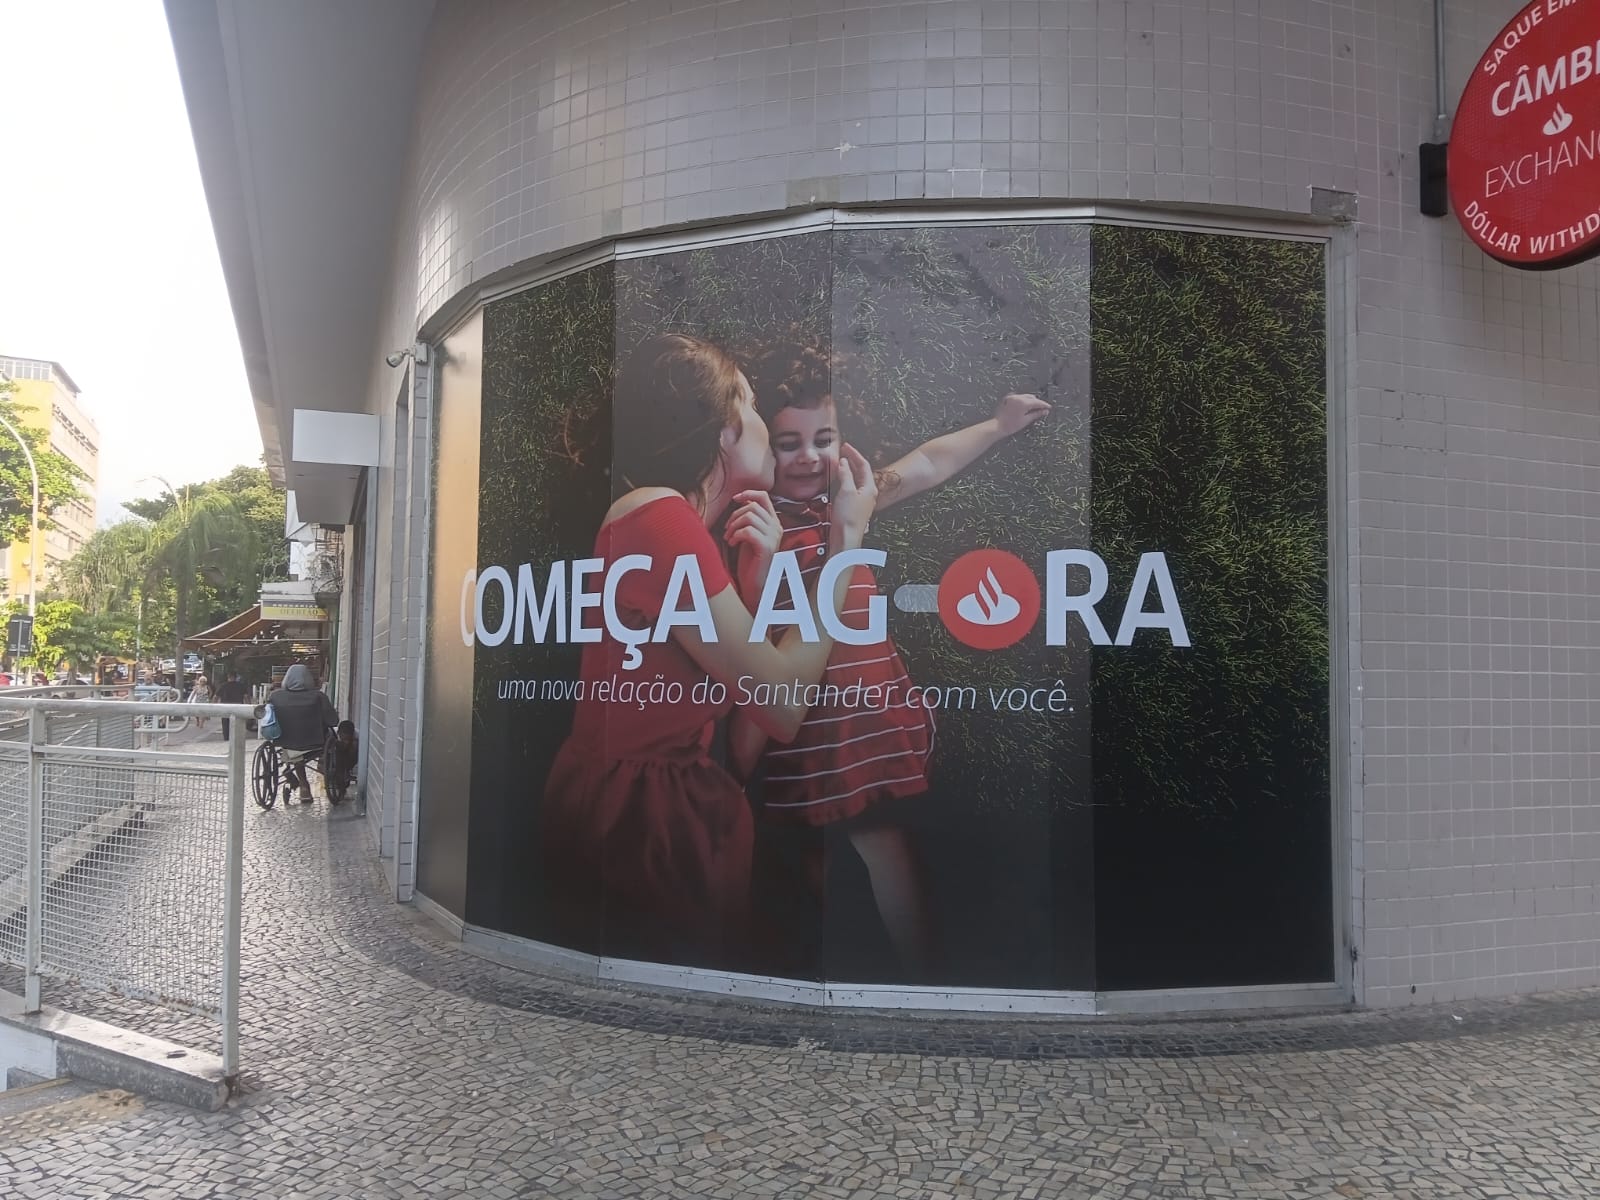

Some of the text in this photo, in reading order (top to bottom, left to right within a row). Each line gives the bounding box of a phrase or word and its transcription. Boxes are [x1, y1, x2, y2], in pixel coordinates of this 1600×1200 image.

[1483, 6, 1544, 76] SAQUE
[1484, 129, 1600, 198] EXCHAN
[1530, 205, 1600, 254] WITHD
[460, 554, 719, 670] COMEÇA
[497, 674, 1075, 713] uma nova relação do Santander com você.
